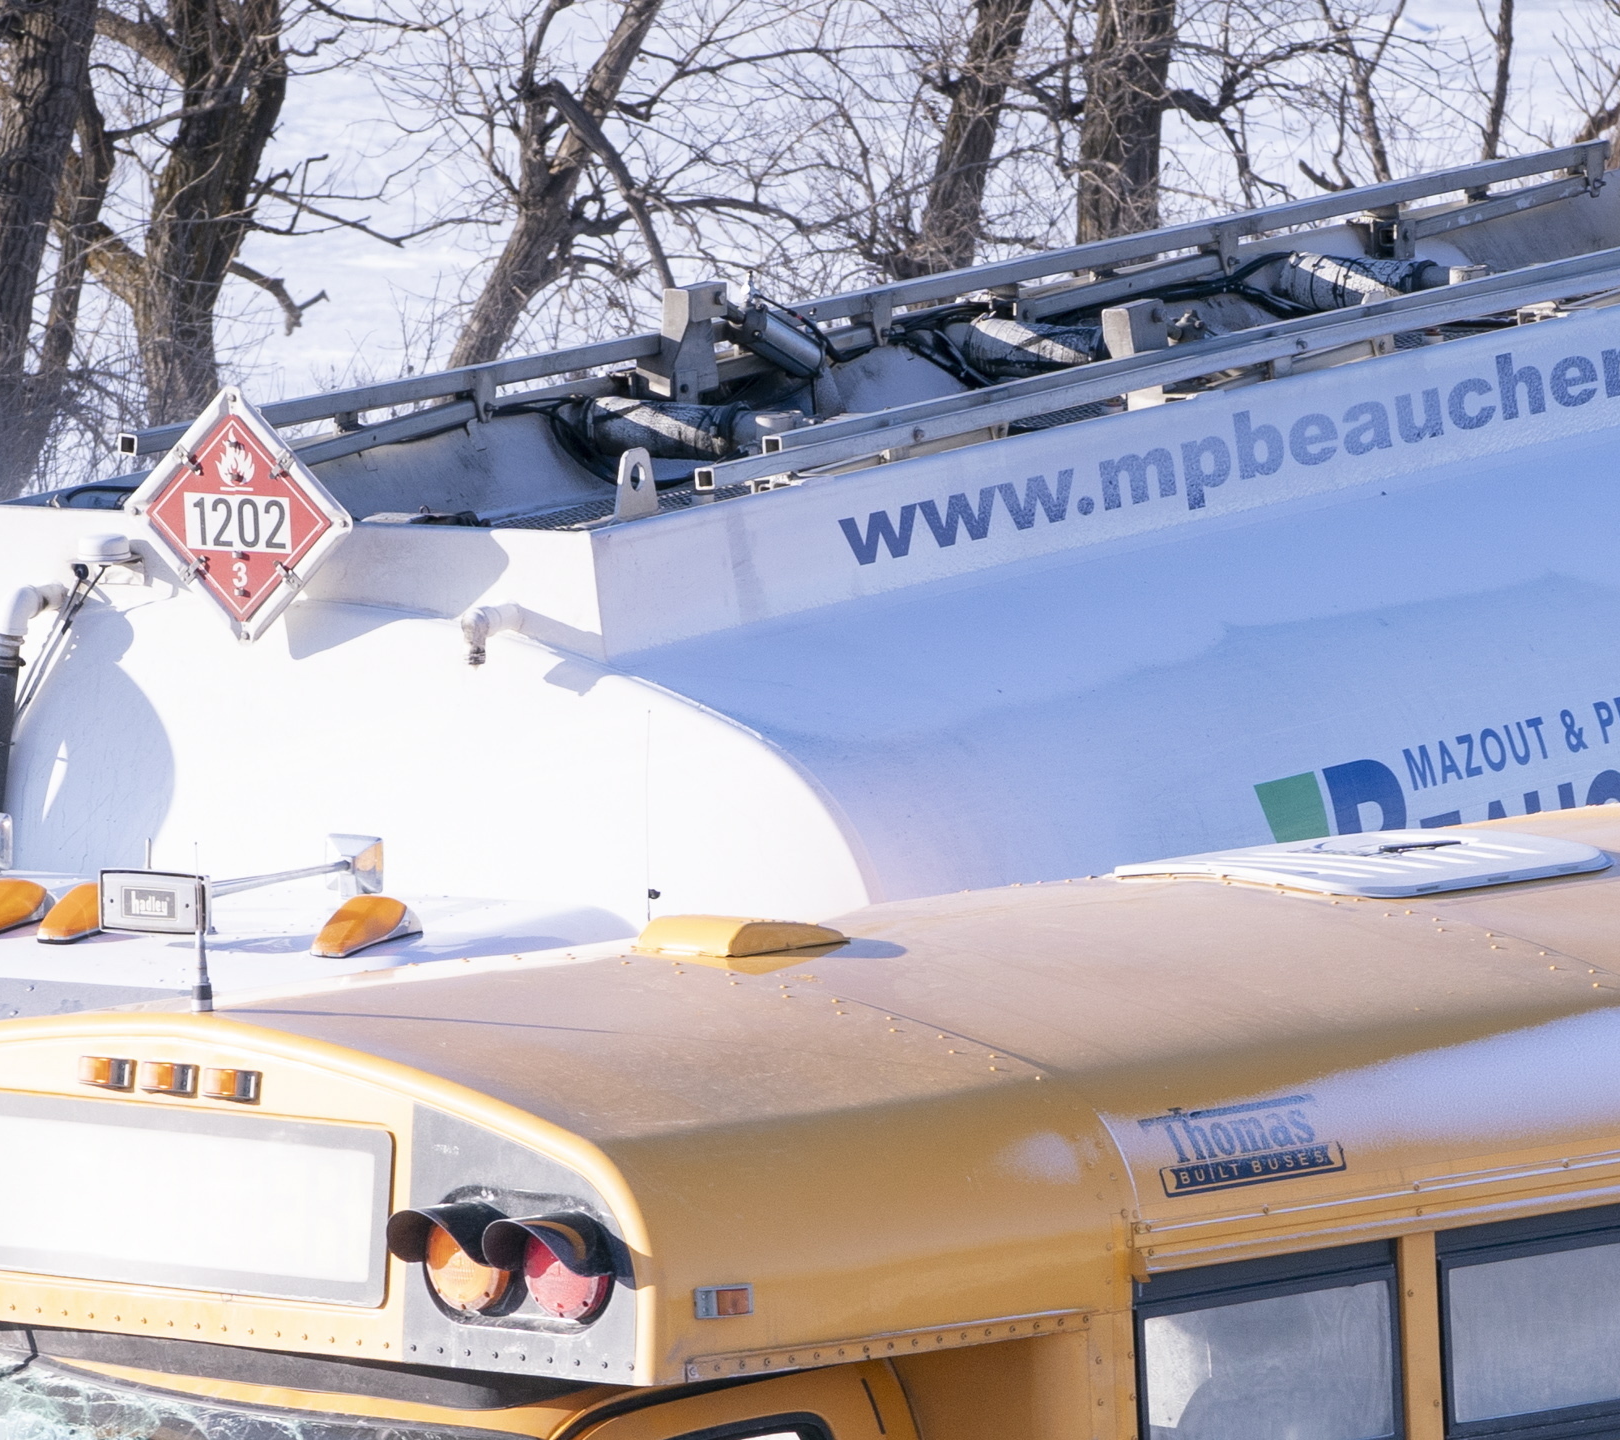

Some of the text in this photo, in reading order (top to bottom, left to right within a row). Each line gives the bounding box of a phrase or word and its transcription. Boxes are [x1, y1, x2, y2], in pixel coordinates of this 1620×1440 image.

[193, 496, 287, 550] 1202
[232, 562, 248, 588] 3
[1402, 716, 1548, 791] MAZOUT
[1559, 708, 1588, 754] &
[131, 890, 168, 916] hadley
[1137, 1093, 1316, 1164] Thomas
[1179, 1150, 1325, 1185] BUILT BUSES
